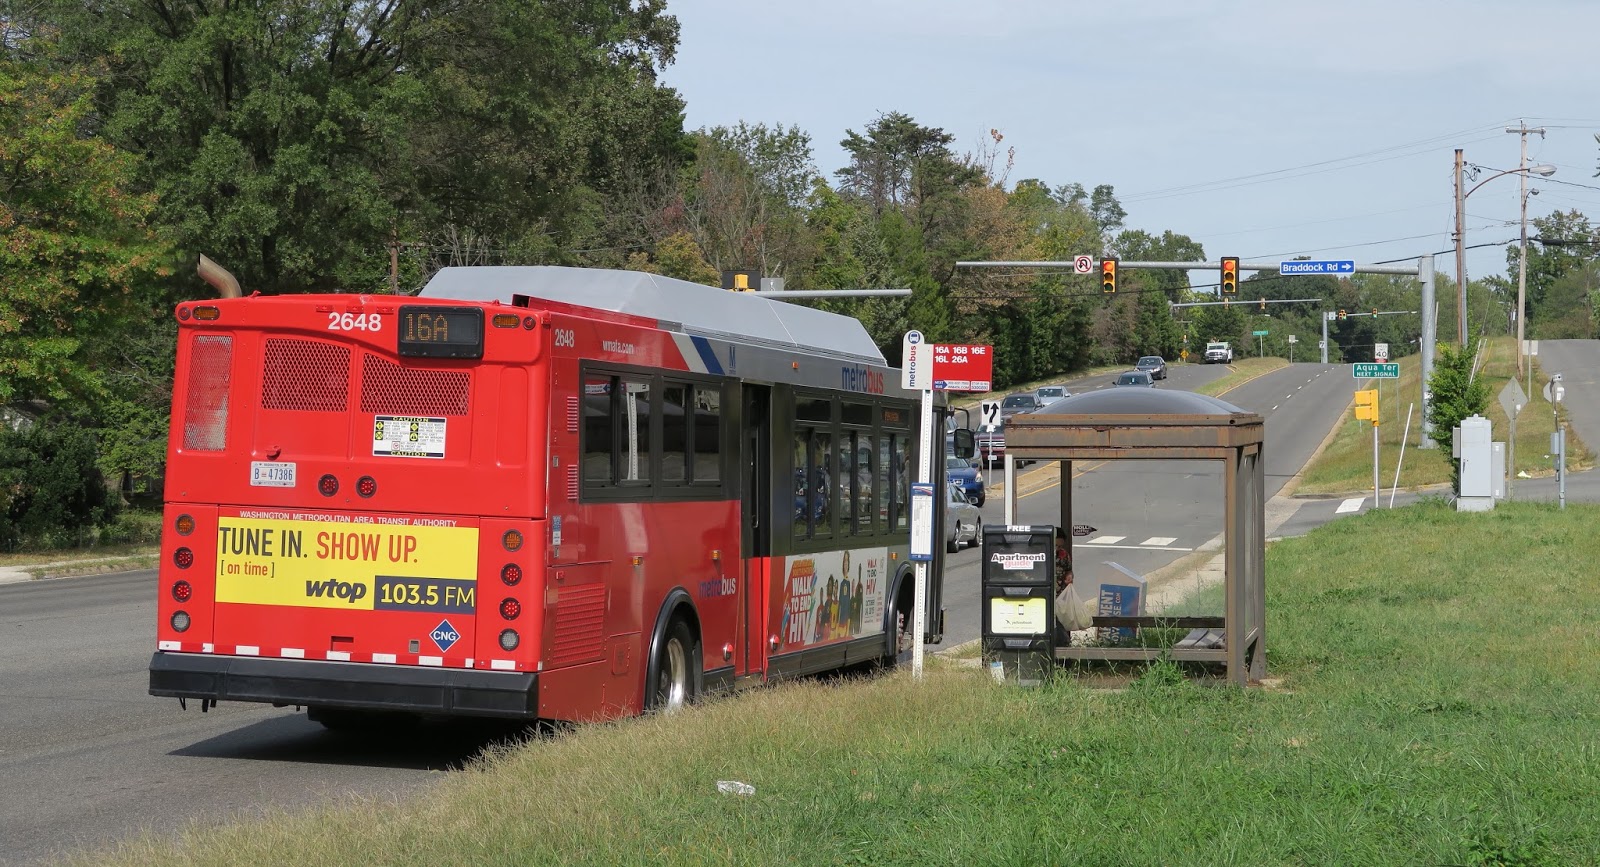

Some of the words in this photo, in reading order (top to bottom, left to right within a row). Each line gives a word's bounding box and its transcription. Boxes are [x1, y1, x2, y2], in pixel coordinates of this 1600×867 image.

[1282, 263, 1324, 272] Braddock
[1327, 263, 1338, 271] Rd
[328, 312, 382, 332] 2648
[405, 313, 448, 342] 16A
[554, 328, 575, 348] 2648
[602, 339, 634, 355] wmata.com
[934, 346, 950, 354] 16A
[952, 346, 968, 354] 16B
[970, 346, 986, 355] 16E
[934, 355, 949, 363] 16L
[908, 345, 917, 387] metrobus
[1356, 364, 1378, 372] Aqua
[841, 363, 884, 395] metrobus
[254, 467, 260, 480] B
[268, 468, 293, 481] 47386
[239, 510, 290, 520] WASHINGTON
[292, 513, 351, 523] METROPOLITAN
[353, 516, 374, 524] AREA
[377, 516, 410, 526] TRANSIT
[412, 518, 457, 528] AUTHORITY
[219, 526, 274, 557] TUNE
[280, 529, 308, 558] IN.
[316, 531, 381, 562] SHOW
[388, 534, 418, 563] UP.
[992, 553, 1045, 562] Apartment
[1004, 560, 1031, 568] guide
[306, 578, 367, 603] wtop
[381, 583, 439, 606] 103.5
[445, 586, 475, 608] FM
[698, 574, 737, 598] metrobus
[792, 575, 812, 597] WALK
[791, 597, 800, 614] TO
[800, 594, 812, 612] END
[433, 630, 457, 641] CNG
[789, 610, 811, 644] HIV
